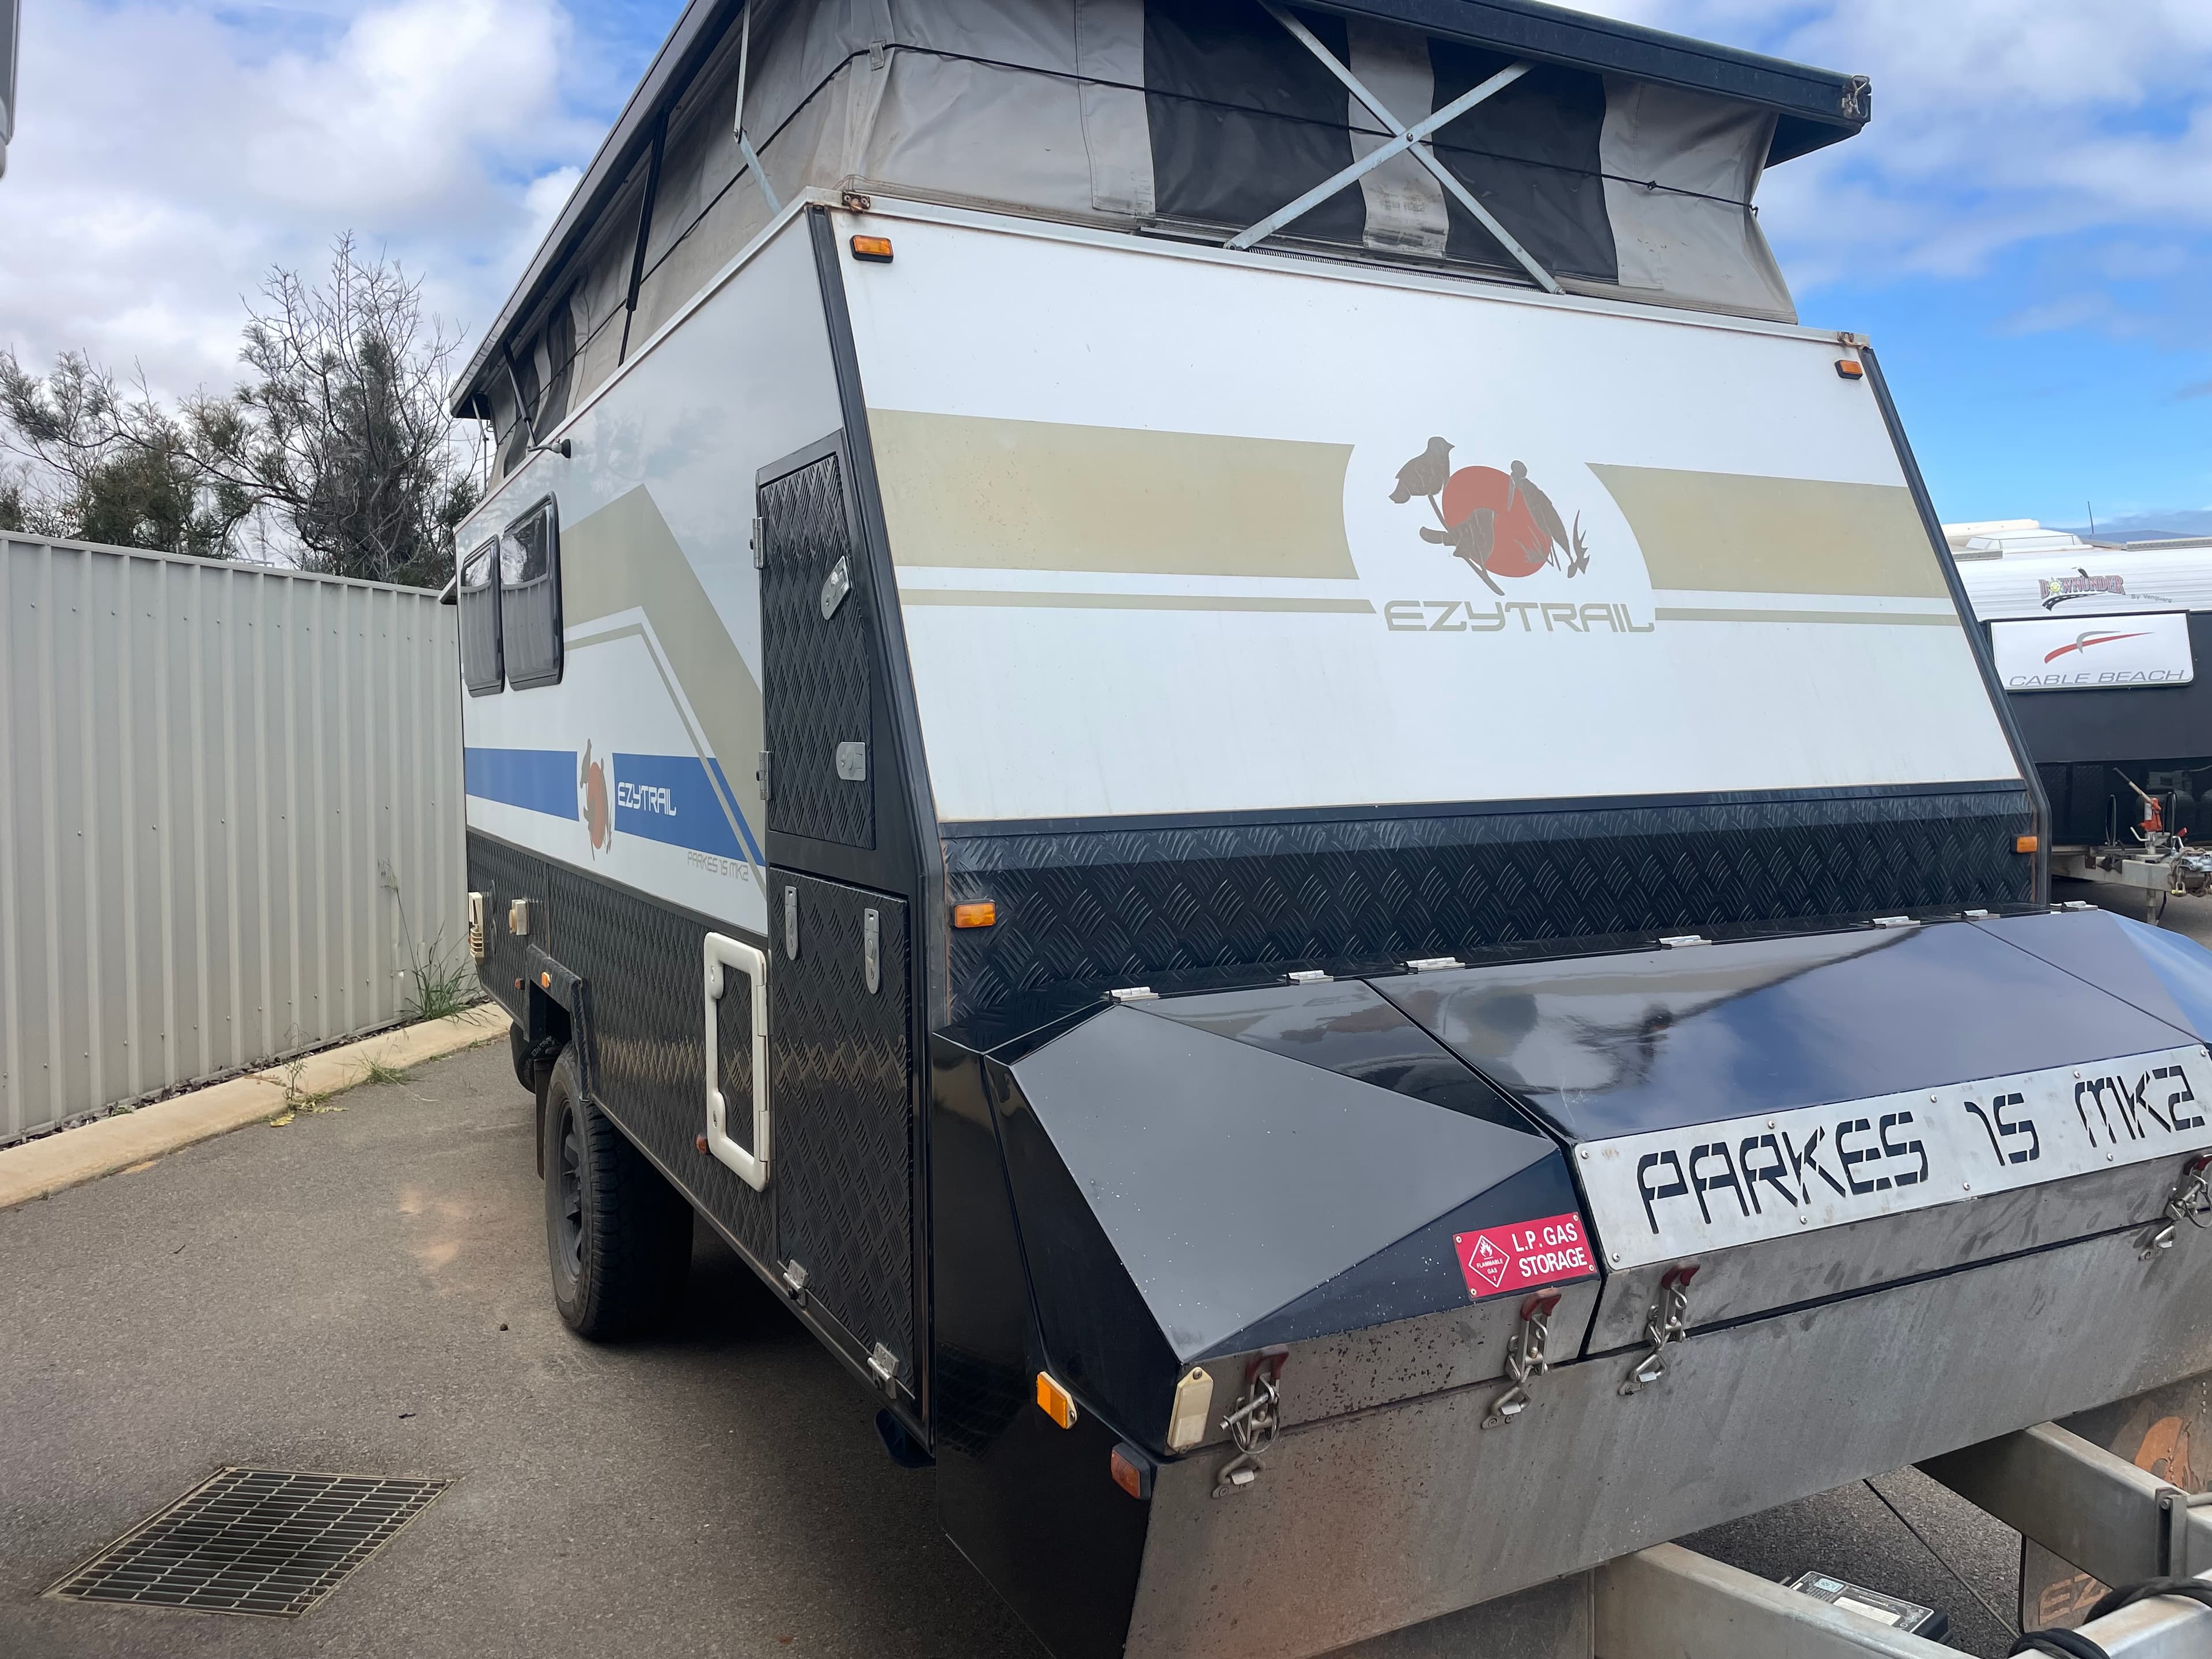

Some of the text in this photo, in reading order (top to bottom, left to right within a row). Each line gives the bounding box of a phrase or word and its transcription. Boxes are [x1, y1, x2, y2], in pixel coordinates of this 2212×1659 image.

[2037, 575, 2126, 599] DOWNUNDER
[2143, 594, 2173, 603] Vanguard
[1384, 599, 1655, 632] EZYTRAIL
[2009, 669, 2185, 687] CABLE BEACH
[618, 782, 676, 816] EZYTRAIL
[687, 851, 749, 882] PARKES 15 MK2
[1637, 1064, 2207, 1235] PARKES 15 MK2
[1512, 1223, 1578, 1252] L.P. GAS
[1476, 1258, 1503, 1268] FLAMMABLE
[1519, 1247, 1588, 1277] STORAGE
